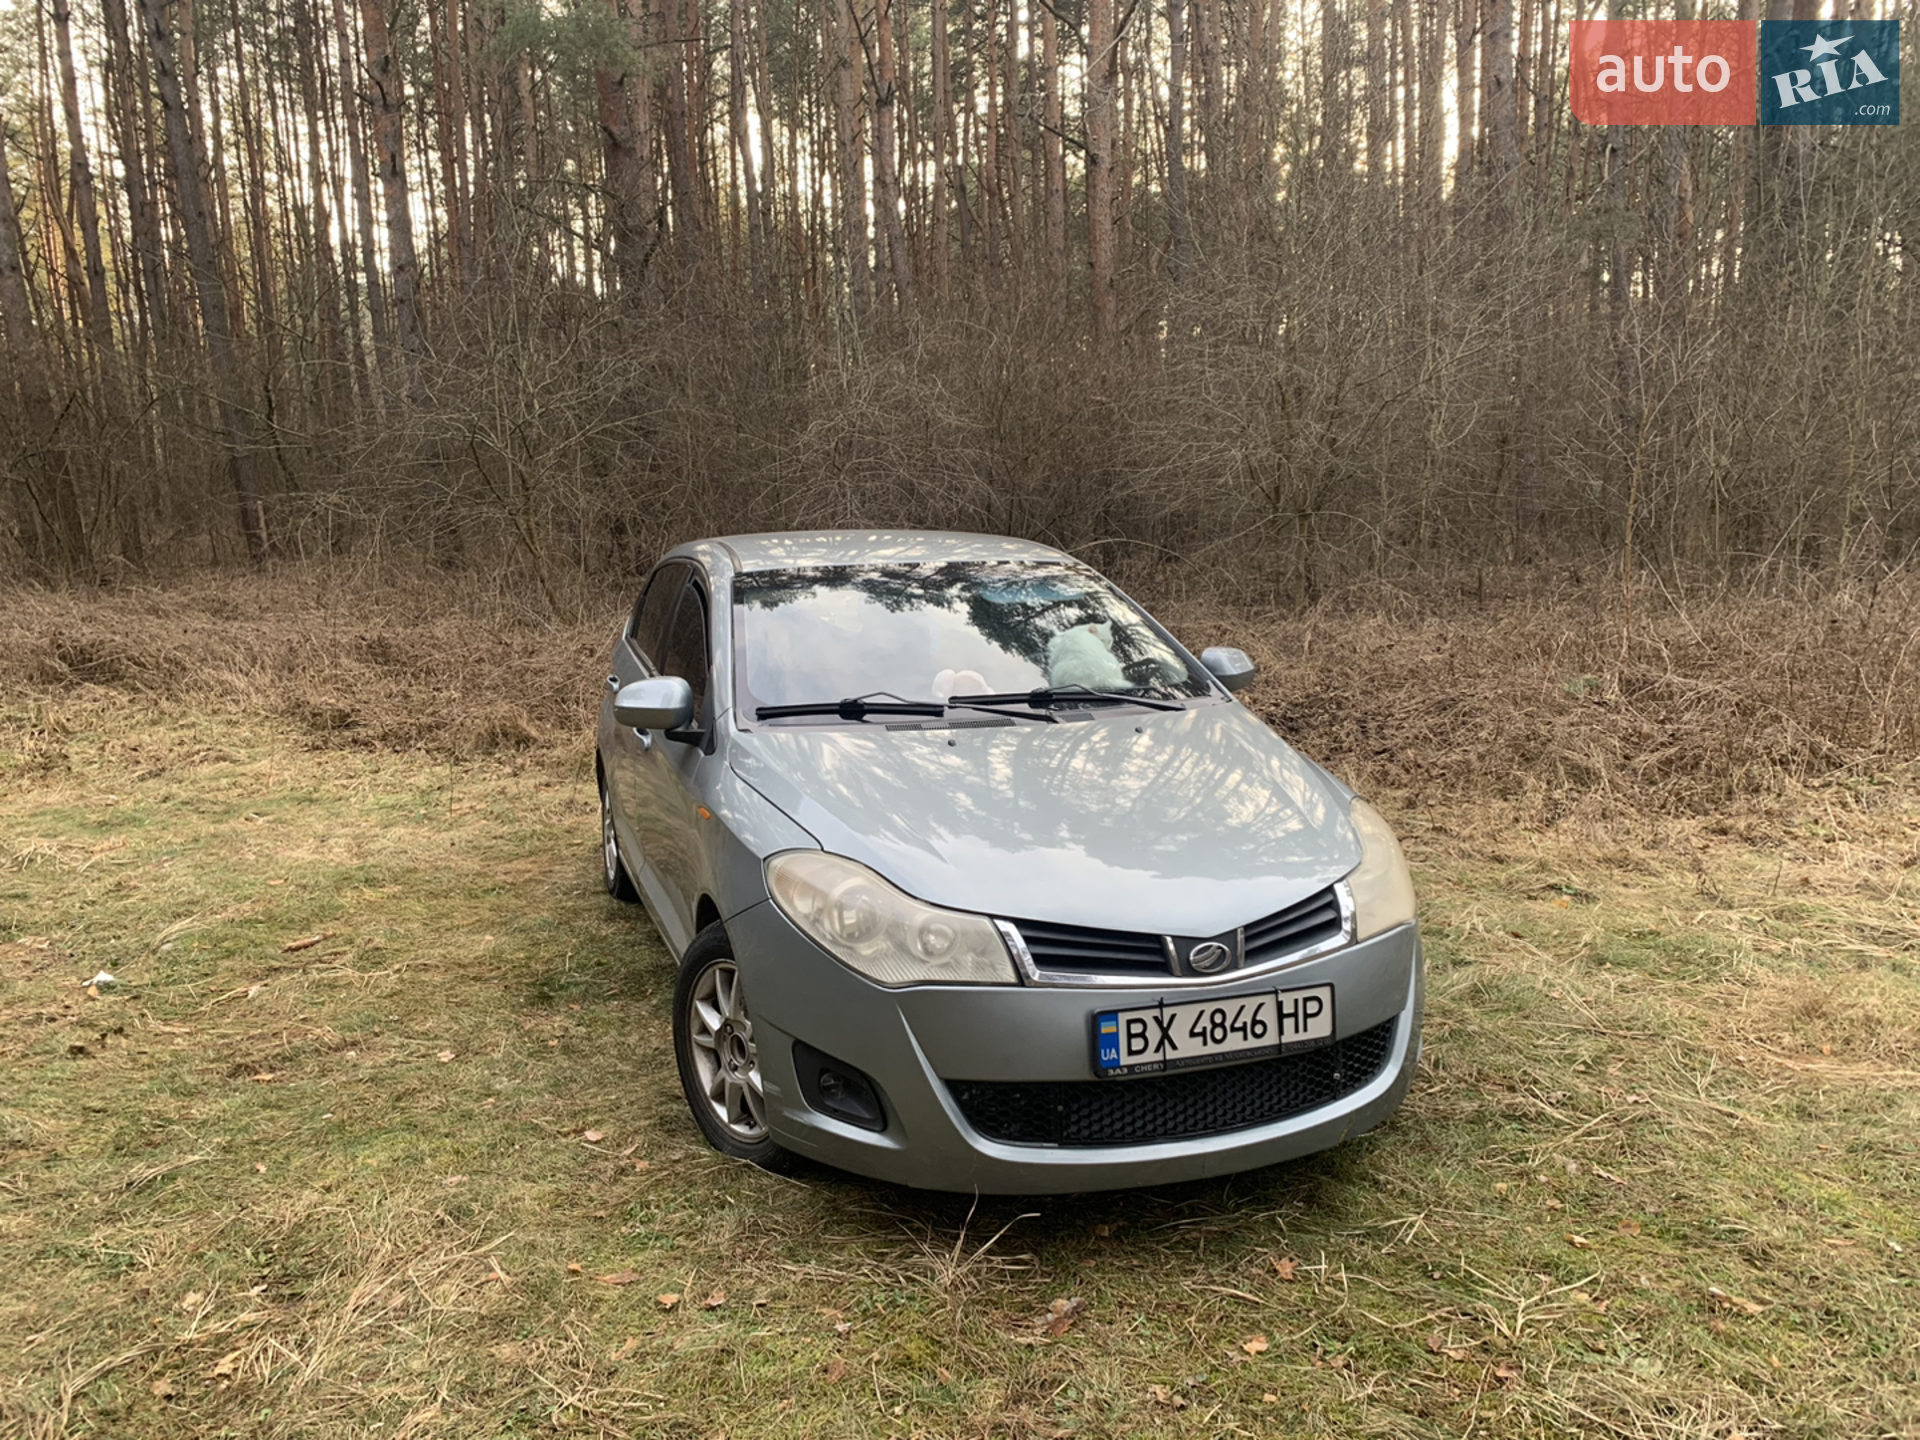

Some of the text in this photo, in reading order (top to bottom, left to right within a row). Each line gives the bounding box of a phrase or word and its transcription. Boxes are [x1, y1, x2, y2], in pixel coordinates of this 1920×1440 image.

[1125, 995, 1324, 1057] BX 4846 HP
[1101, 1047, 1118, 1060] UA
[1134, 1062, 1164, 1073] CHERY
